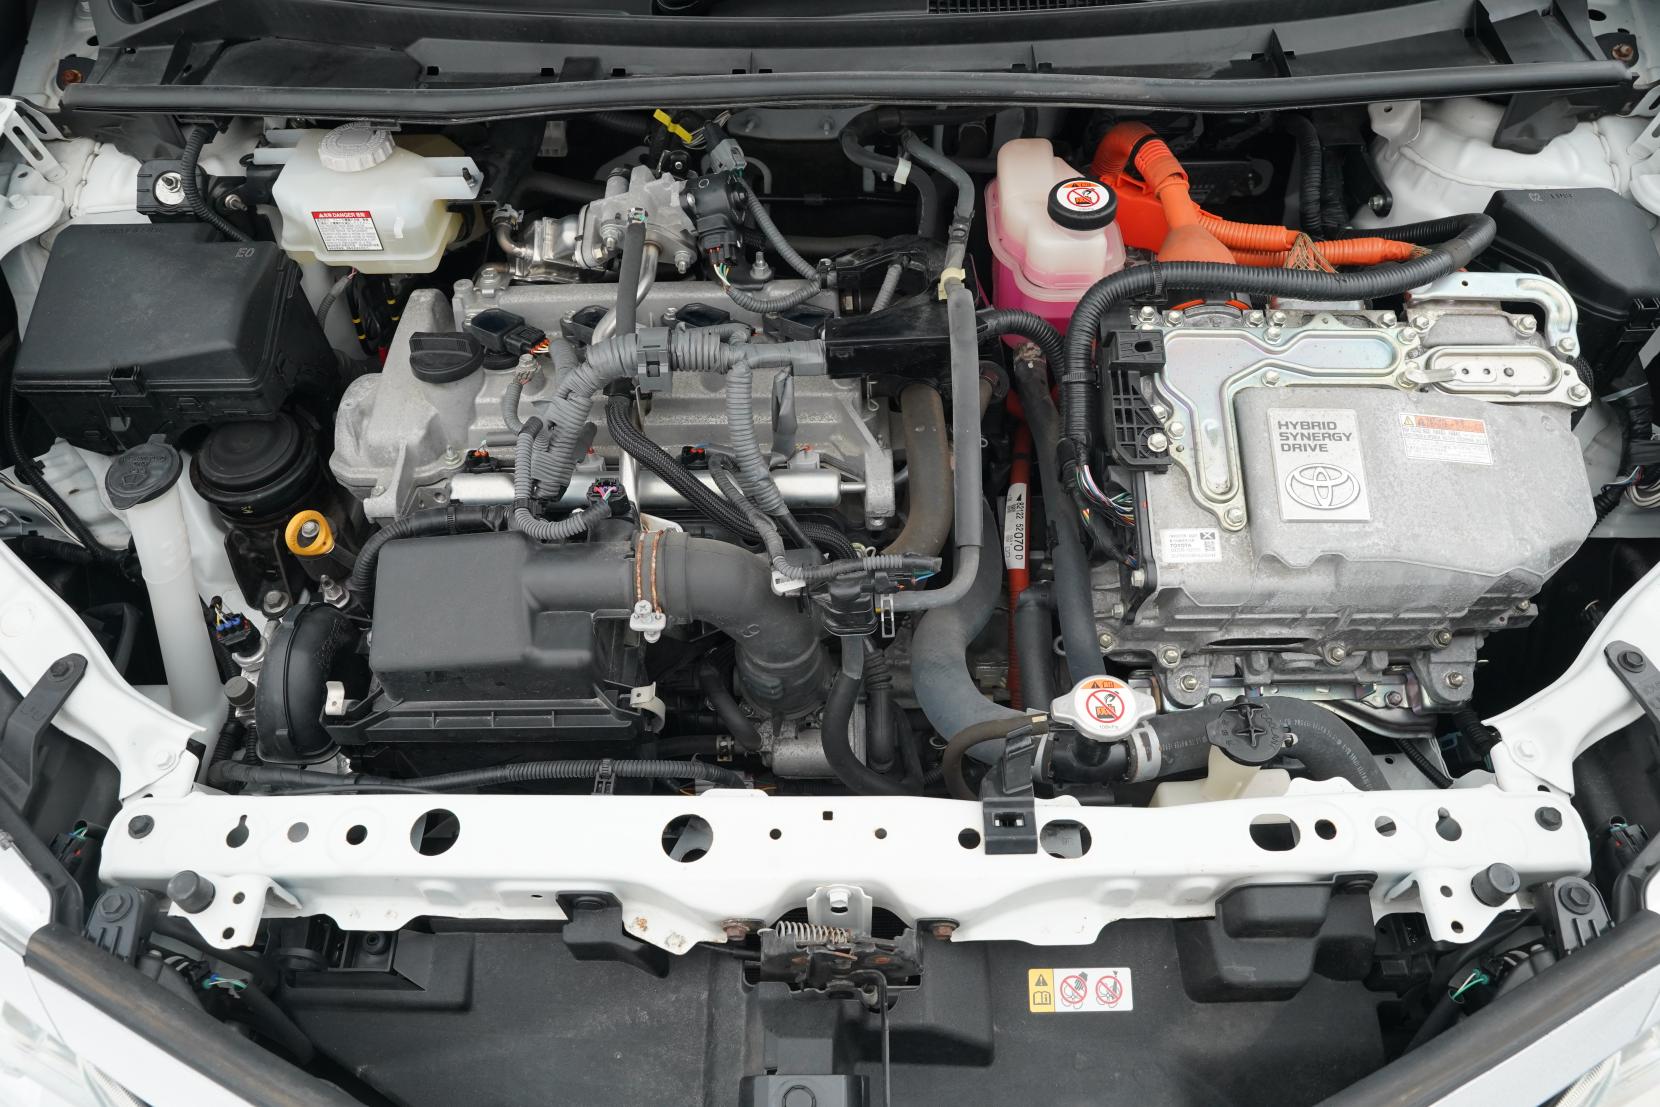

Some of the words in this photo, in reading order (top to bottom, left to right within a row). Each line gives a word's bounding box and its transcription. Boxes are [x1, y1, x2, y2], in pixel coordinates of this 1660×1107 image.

[1277, 420, 1337, 431] HYBRID
[1279, 432, 1353, 442] SYNERGY
[1280, 443, 1329, 453] DRIVE
[1013, 523, 1024, 552] 52070
